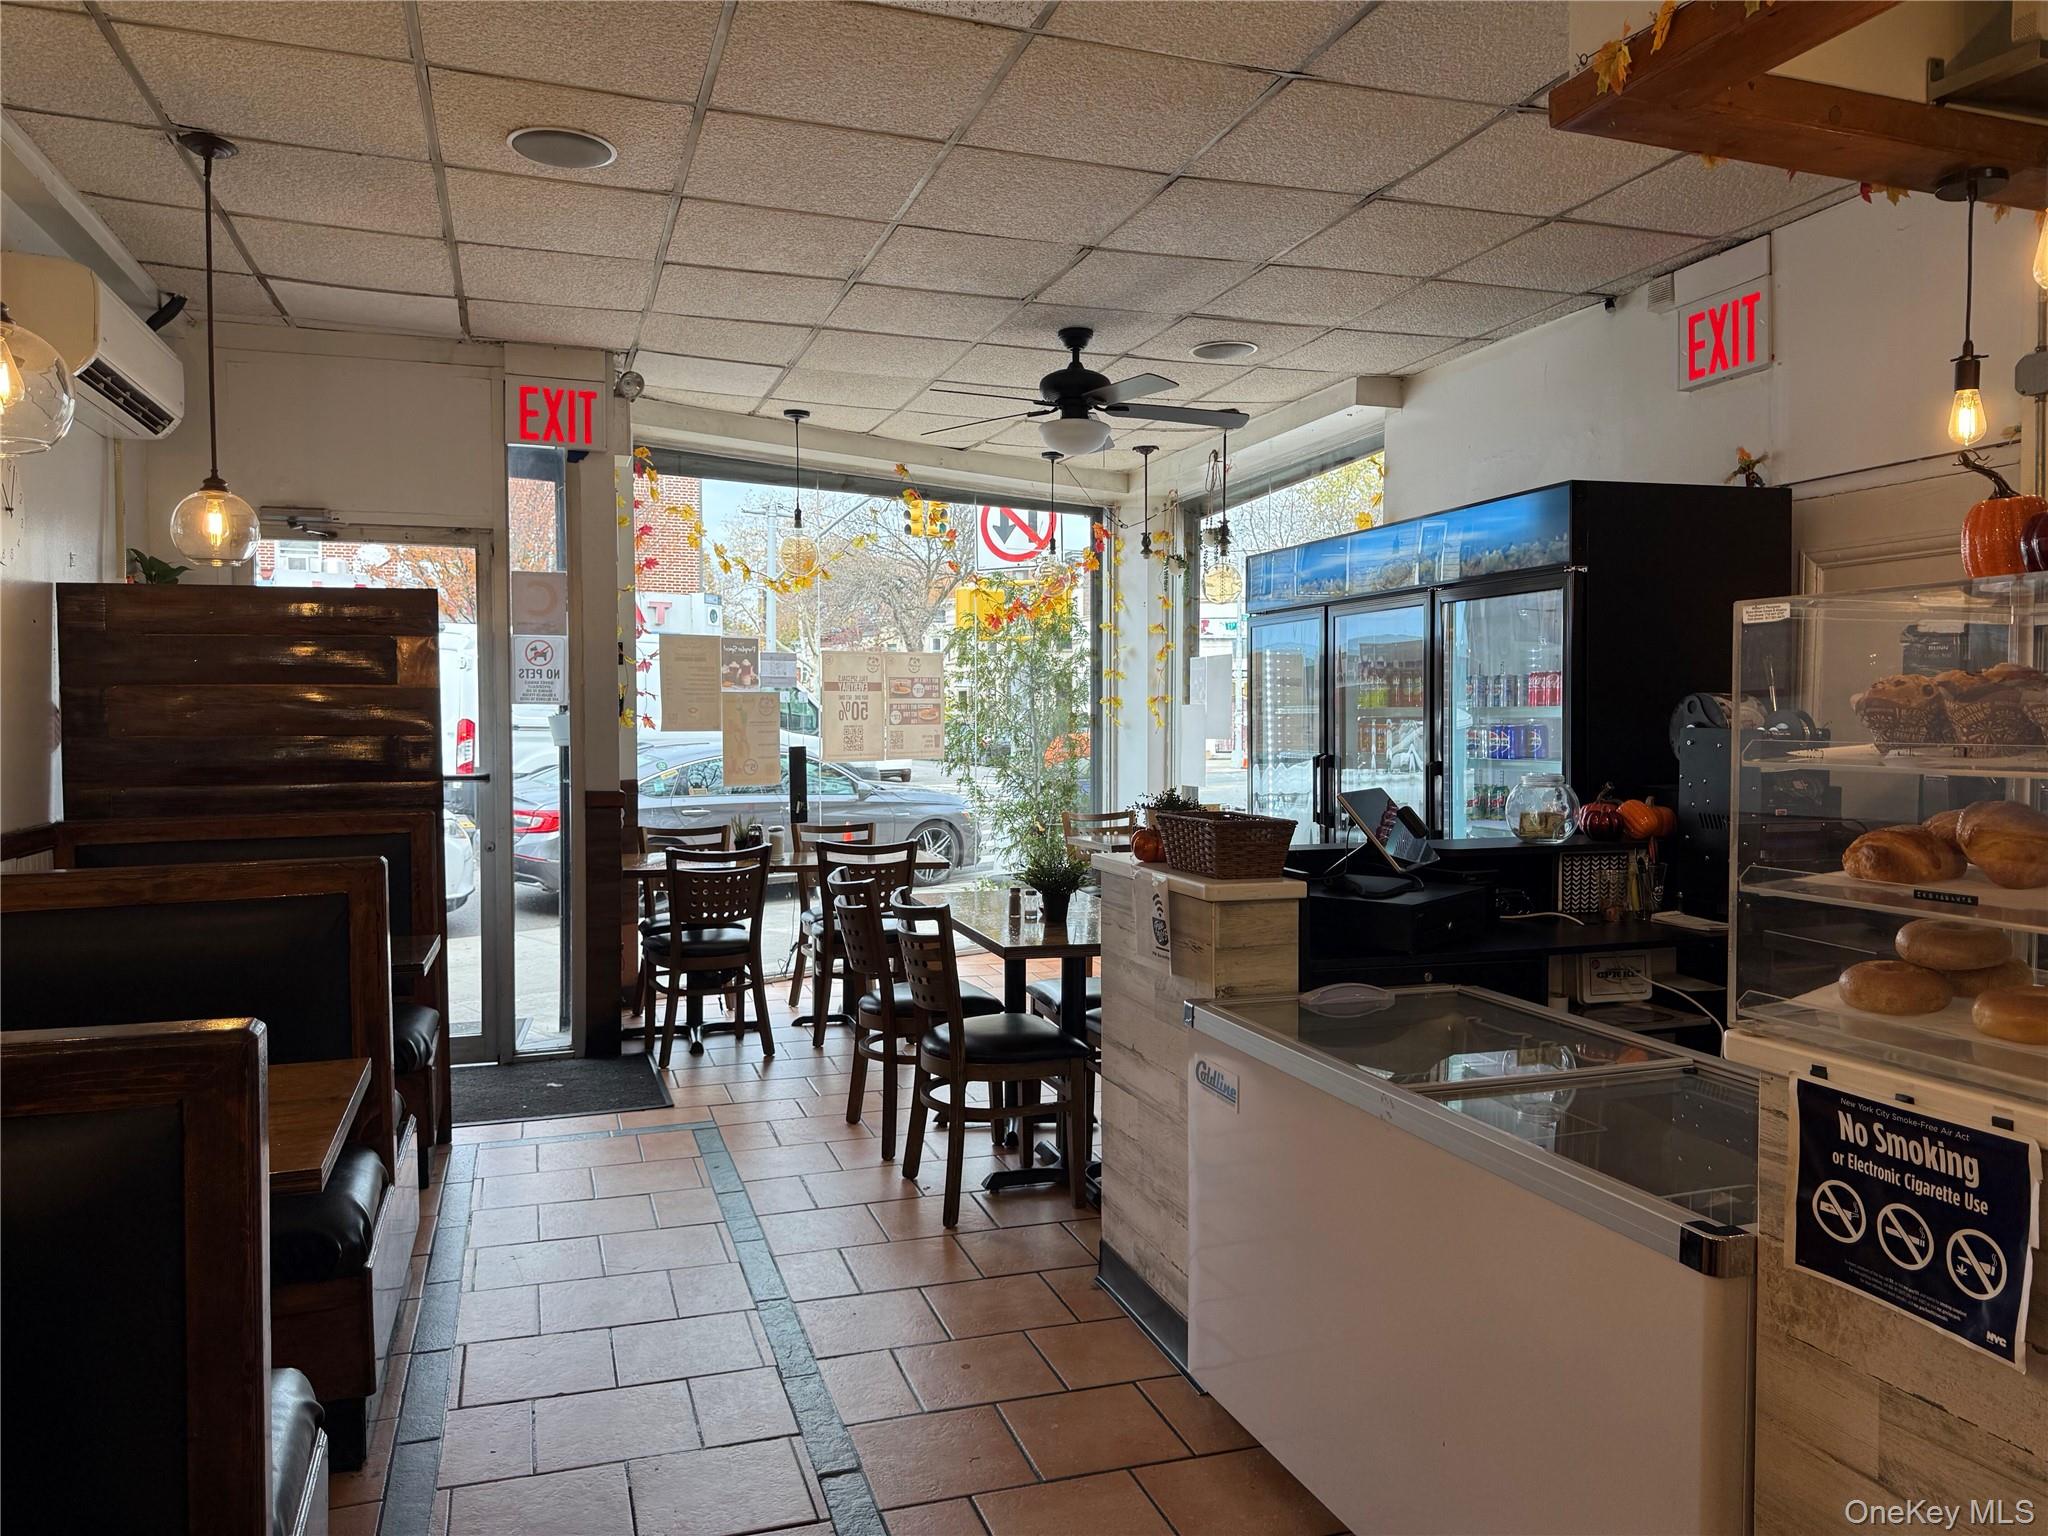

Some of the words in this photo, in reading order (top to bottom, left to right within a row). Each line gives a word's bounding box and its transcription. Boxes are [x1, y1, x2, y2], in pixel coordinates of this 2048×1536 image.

[1688, 291, 1761, 381] EXIT
[519, 386, 598, 445] EXIT
[1195, 1060, 1237, 1101] Coldline
[1838, 1110, 1868, 1147] No
[1873, 1122, 1980, 1188] Smoking
[1840, 1097, 1856, 1108] New
[1858, 1102, 1873, 1113] York
[1875, 1108, 1890, 1120] City
[1892, 1113, 1938, 1133] Smoke-Free
[1940, 1127, 1953, 1137] Air
[1955, 1131, 1970, 1142] Act
[1832, 1152, 1845, 1166] or
[1848, 1153, 1901, 1186] Electronic
[1904, 1173, 1960, 1206] Cigarette
[1964, 1192, 1989, 1216] Use
[1986, 1330, 2007, 1348] NYC
